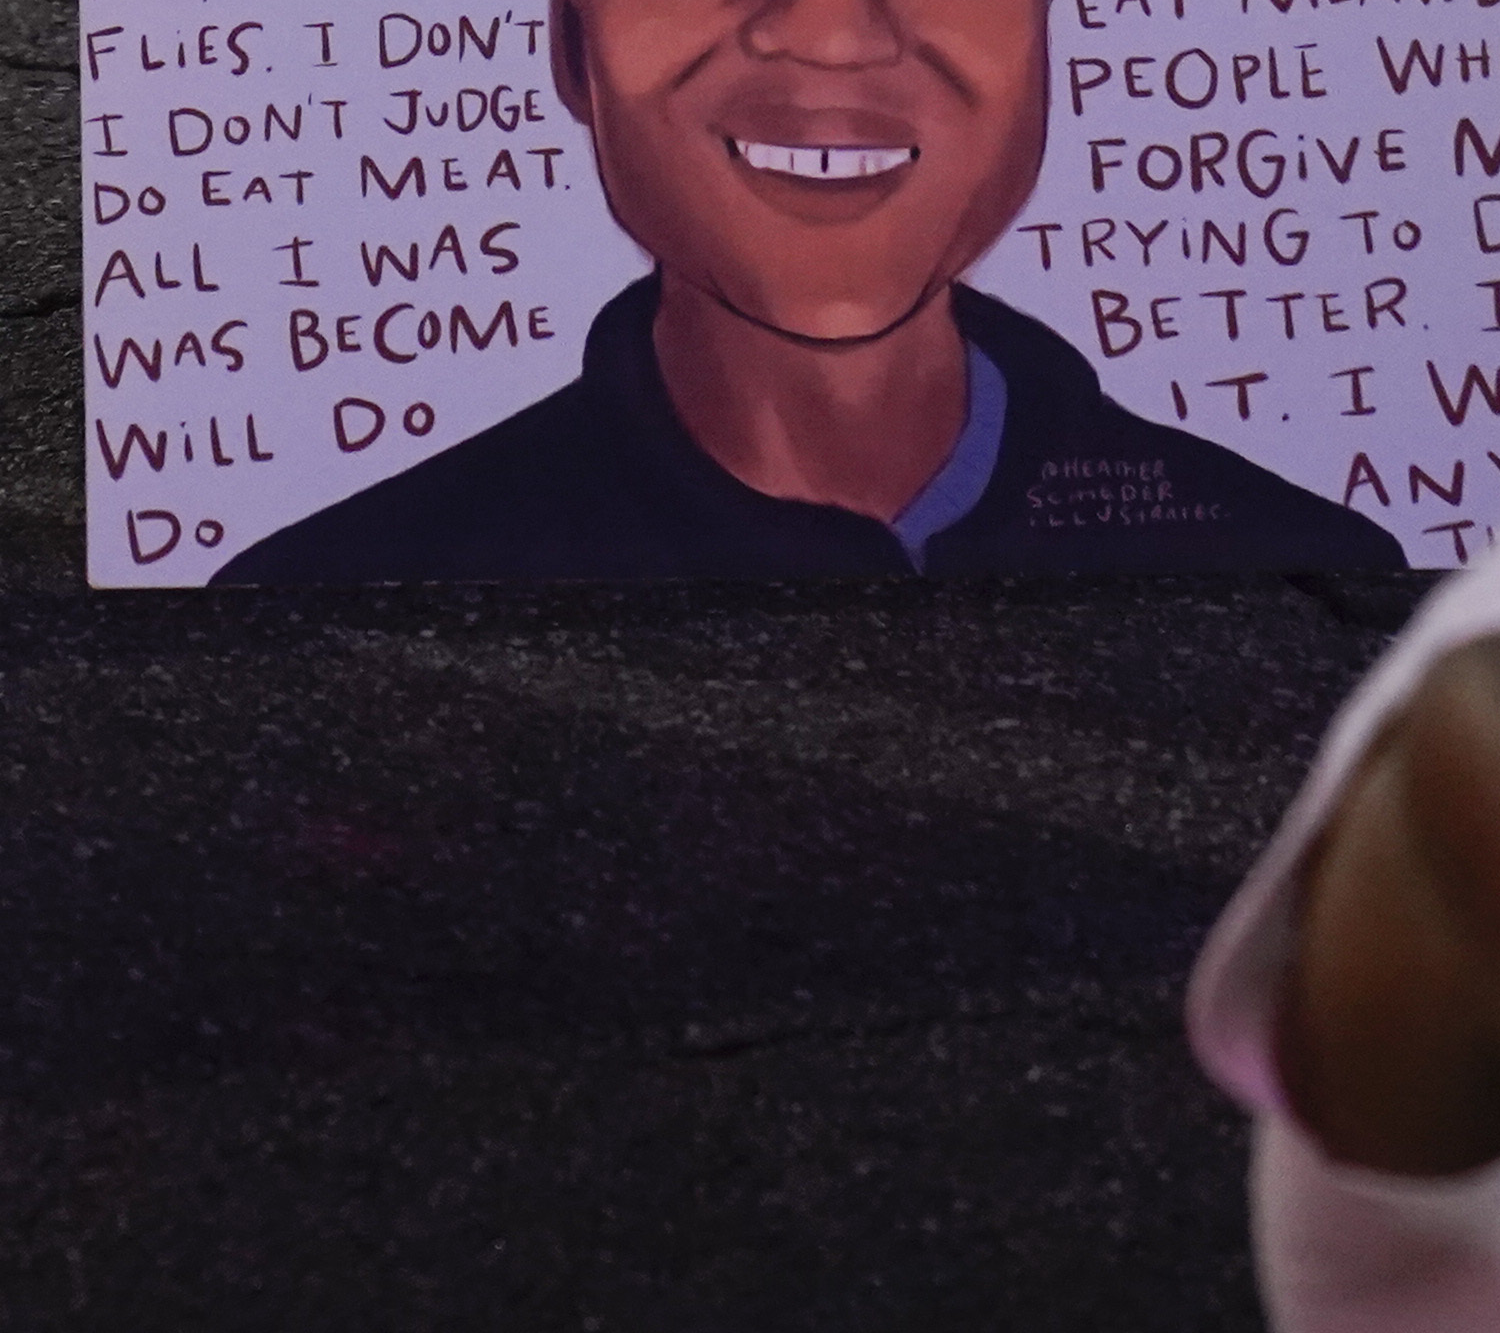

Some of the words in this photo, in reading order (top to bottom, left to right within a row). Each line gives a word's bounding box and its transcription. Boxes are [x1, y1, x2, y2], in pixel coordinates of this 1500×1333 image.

[305, 22, 337, 67] I
[379, 10, 545, 69] DON'T
[88, 114, 128, 157] I
[168, 95, 348, 157] DON'T
[383, 85, 545, 136] JUDGE
[1067, 43, 1327, 117] PEOPLE
[94, 182, 166, 226] DO
[202, 170, 314, 207] EAT
[94, 243, 220, 307] ALL
[275, 236, 320, 288] I
[360, 222, 520, 287] WAS
[1340, 210, 1422, 255] TO
[94, 320, 248, 389] WAS
[289, 301, 555, 372] BECOME
[333, 397, 435, 454] DO
[1331, 365, 1377, 416] I
[126, 509, 224, 565] DO
